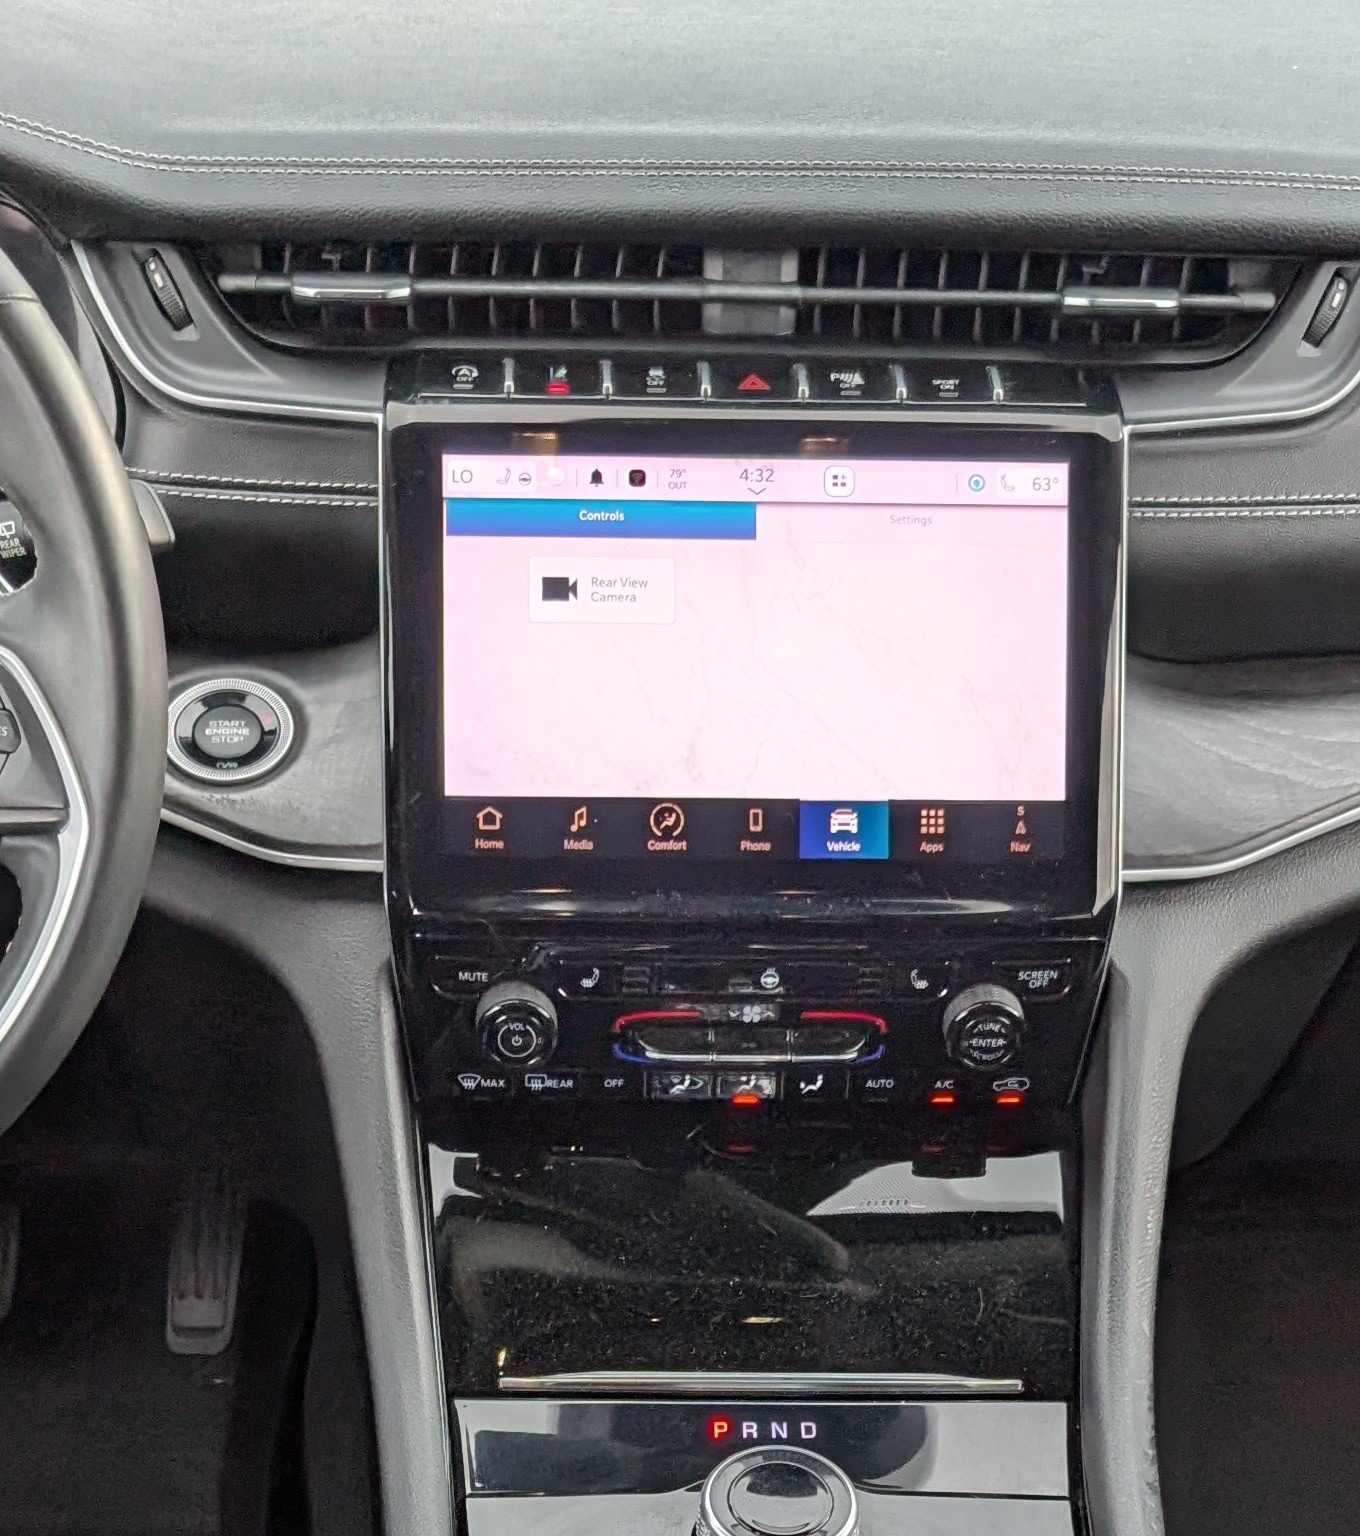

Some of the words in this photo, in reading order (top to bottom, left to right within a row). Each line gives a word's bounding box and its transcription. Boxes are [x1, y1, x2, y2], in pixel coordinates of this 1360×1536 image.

[452, 469, 473, 484] LO
[739, 468, 774, 483] 4:32
[667, 481, 687, 490] OUT
[1032, 477, 1059, 491] 63°
[579, 510, 625, 522] Controls
[889, 515, 932, 527] Settings
[591, 577, 617, 588] Rear
[620, 577, 648, 588] View
[590, 591, 637, 603] Camera
[209, 720, 246, 728] START
[205, 728, 250, 736] ENGINE
[211, 736, 244, 744] STOP
[474, 839, 504, 850] Home
[563, 839, 594, 850] Media
[647, 839, 687, 851] Comfort
[740, 840, 771, 852] Phone
[826, 841, 861, 853] Vehicle
[919, 841, 944, 854] Apps
[1010, 841, 1031, 853] Nav
[458, 971, 489, 982] MUTE
[1018, 970, 1058, 982] SCREEN
[1029, 979, 1049, 988] OFF
[509, 1023, 525, 1031] VOL
[972, 1038, 1004, 1047] ENTER
[480, 1078, 505, 1088] MAX
[547, 1079, 574, 1089] REAR
[604, 1078, 624, 1088] OFF
[866, 1079, 894, 1089] AUTO
[935, 1080, 953, 1090] A/C
[714, 1421, 728, 1439] P
[742, 1421, 757, 1439] R
[771, 1421, 787, 1439] N
[801, 1421, 818, 1439] D
